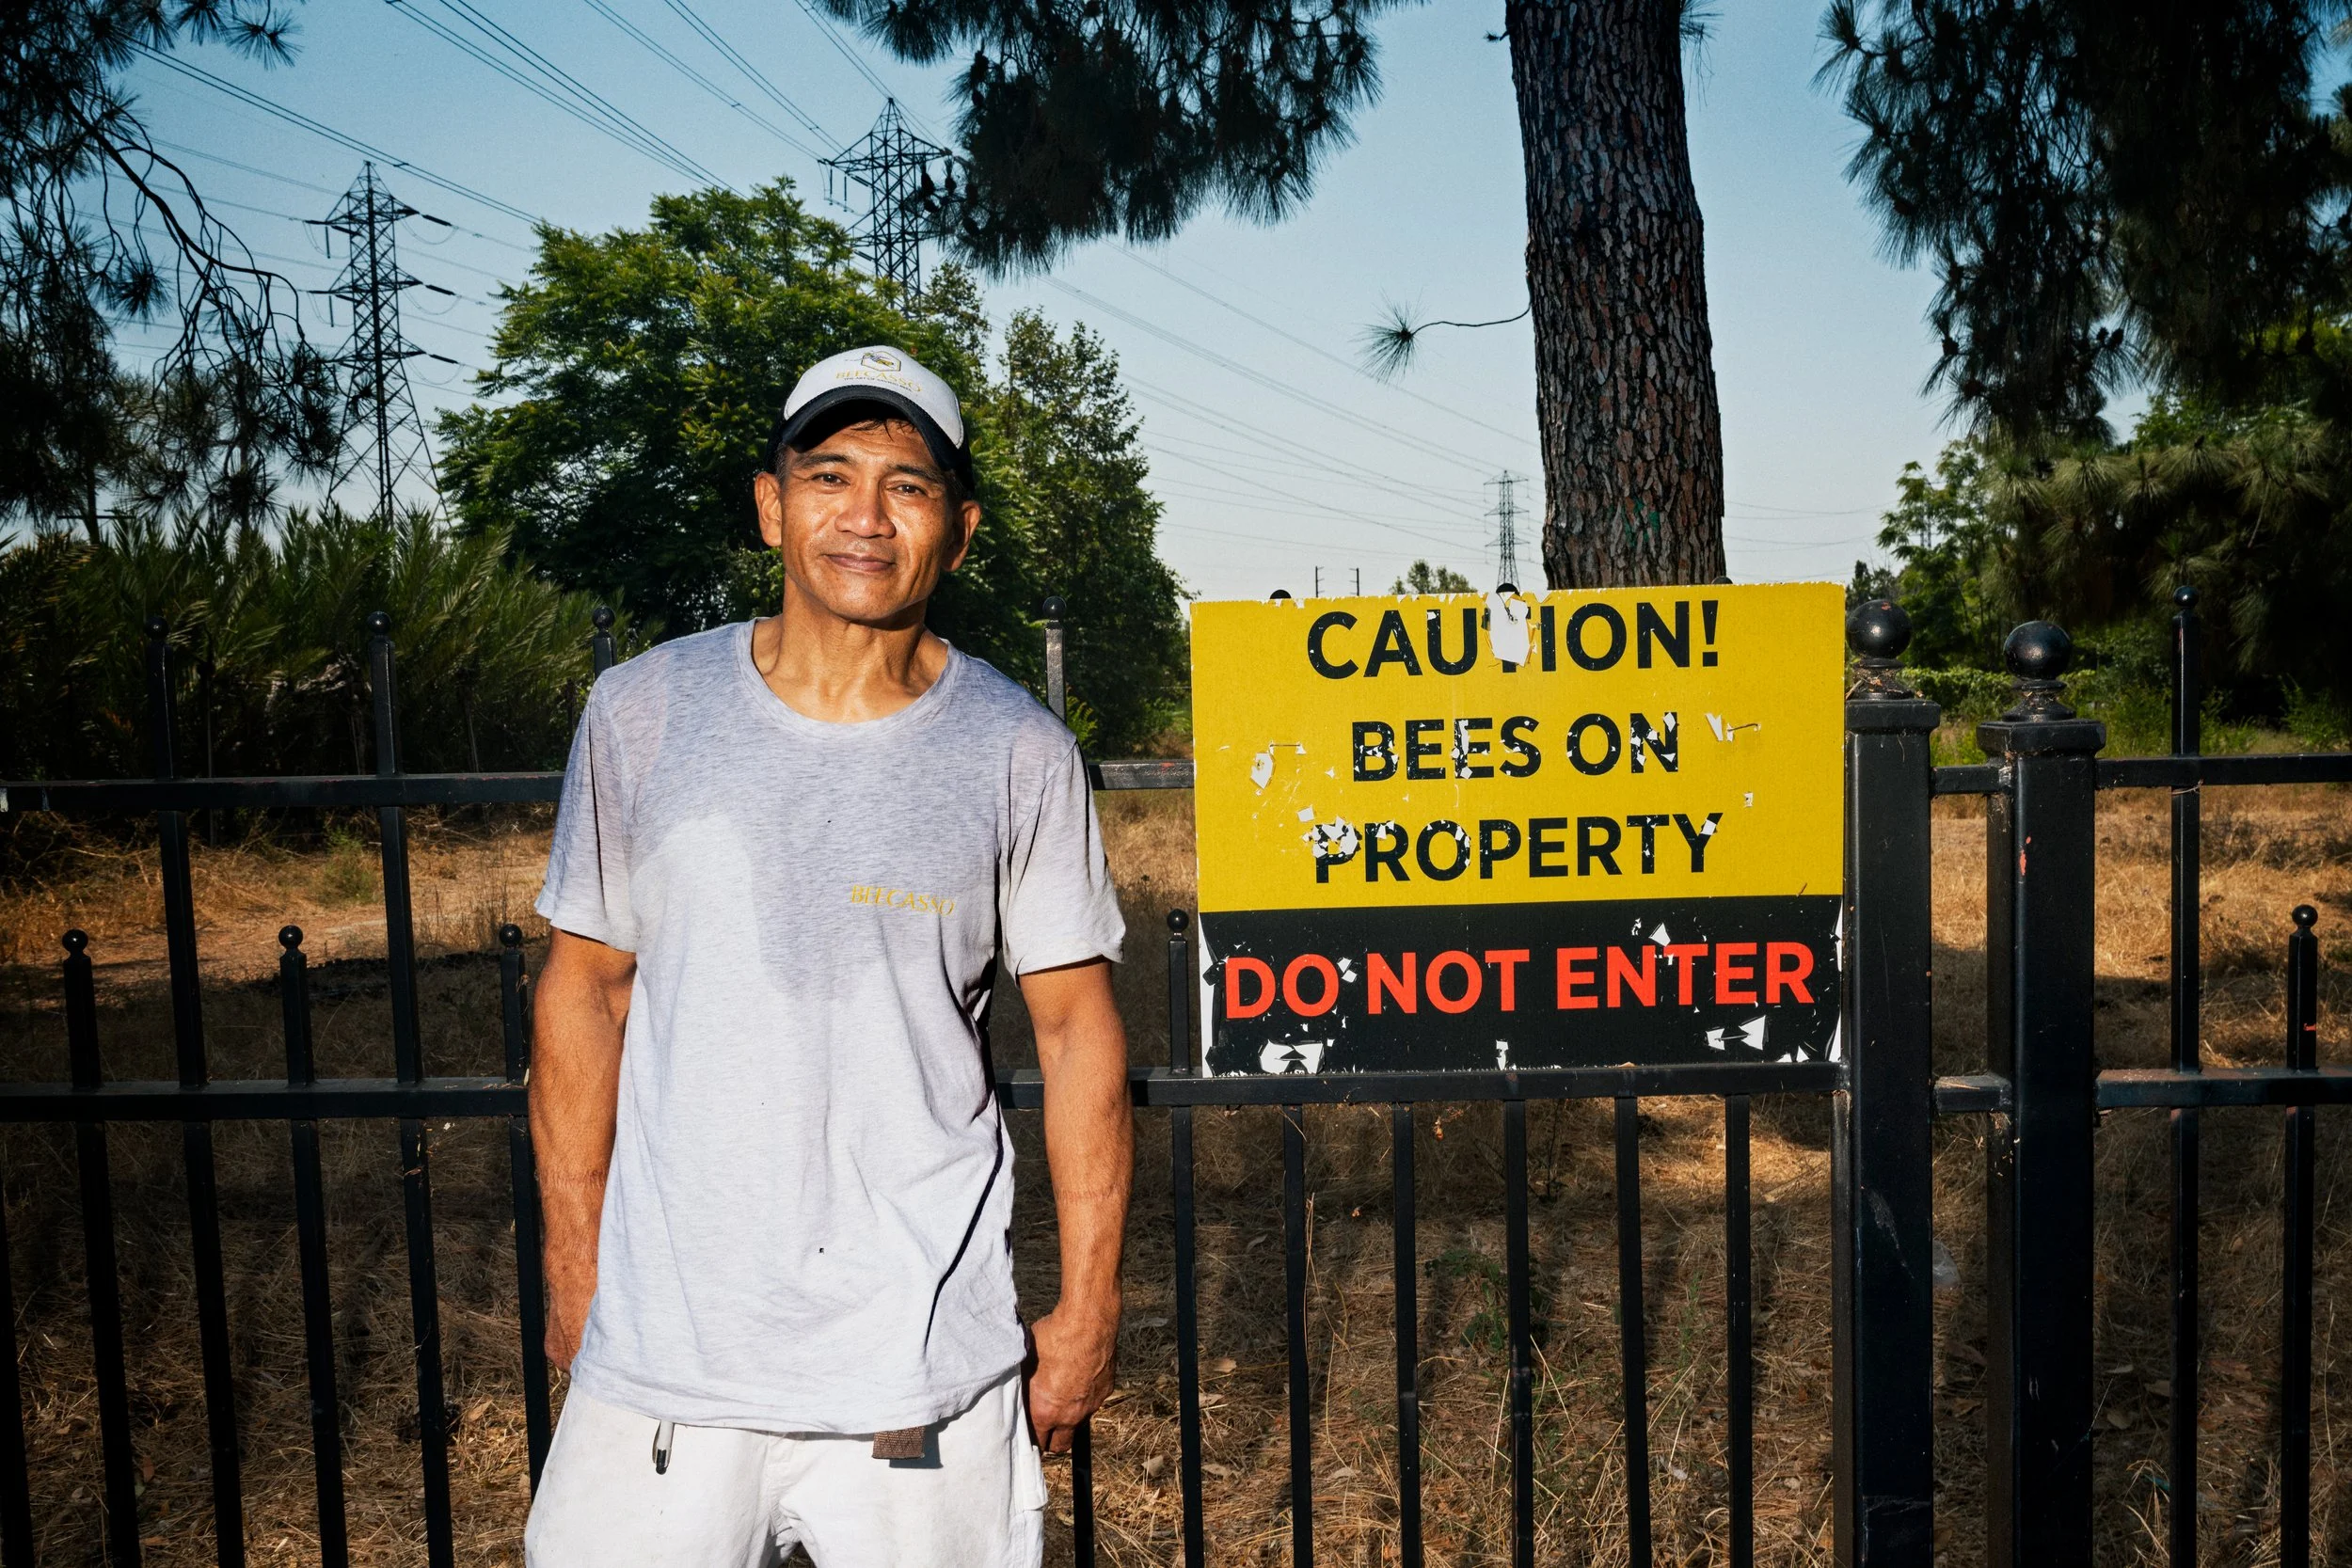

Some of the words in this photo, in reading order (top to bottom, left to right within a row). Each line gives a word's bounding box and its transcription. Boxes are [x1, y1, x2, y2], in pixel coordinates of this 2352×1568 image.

[1307, 600, 1719, 679] CAUION!
[1352, 716, 1541, 782] BEES
[1566, 711, 1678, 776] ON
[851, 884, 955, 916] BEECASSO
[1225, 954, 1340, 1019] DO
[1367, 949, 1530, 1014] NOT
[1556, 942, 1815, 1010] ENTER
